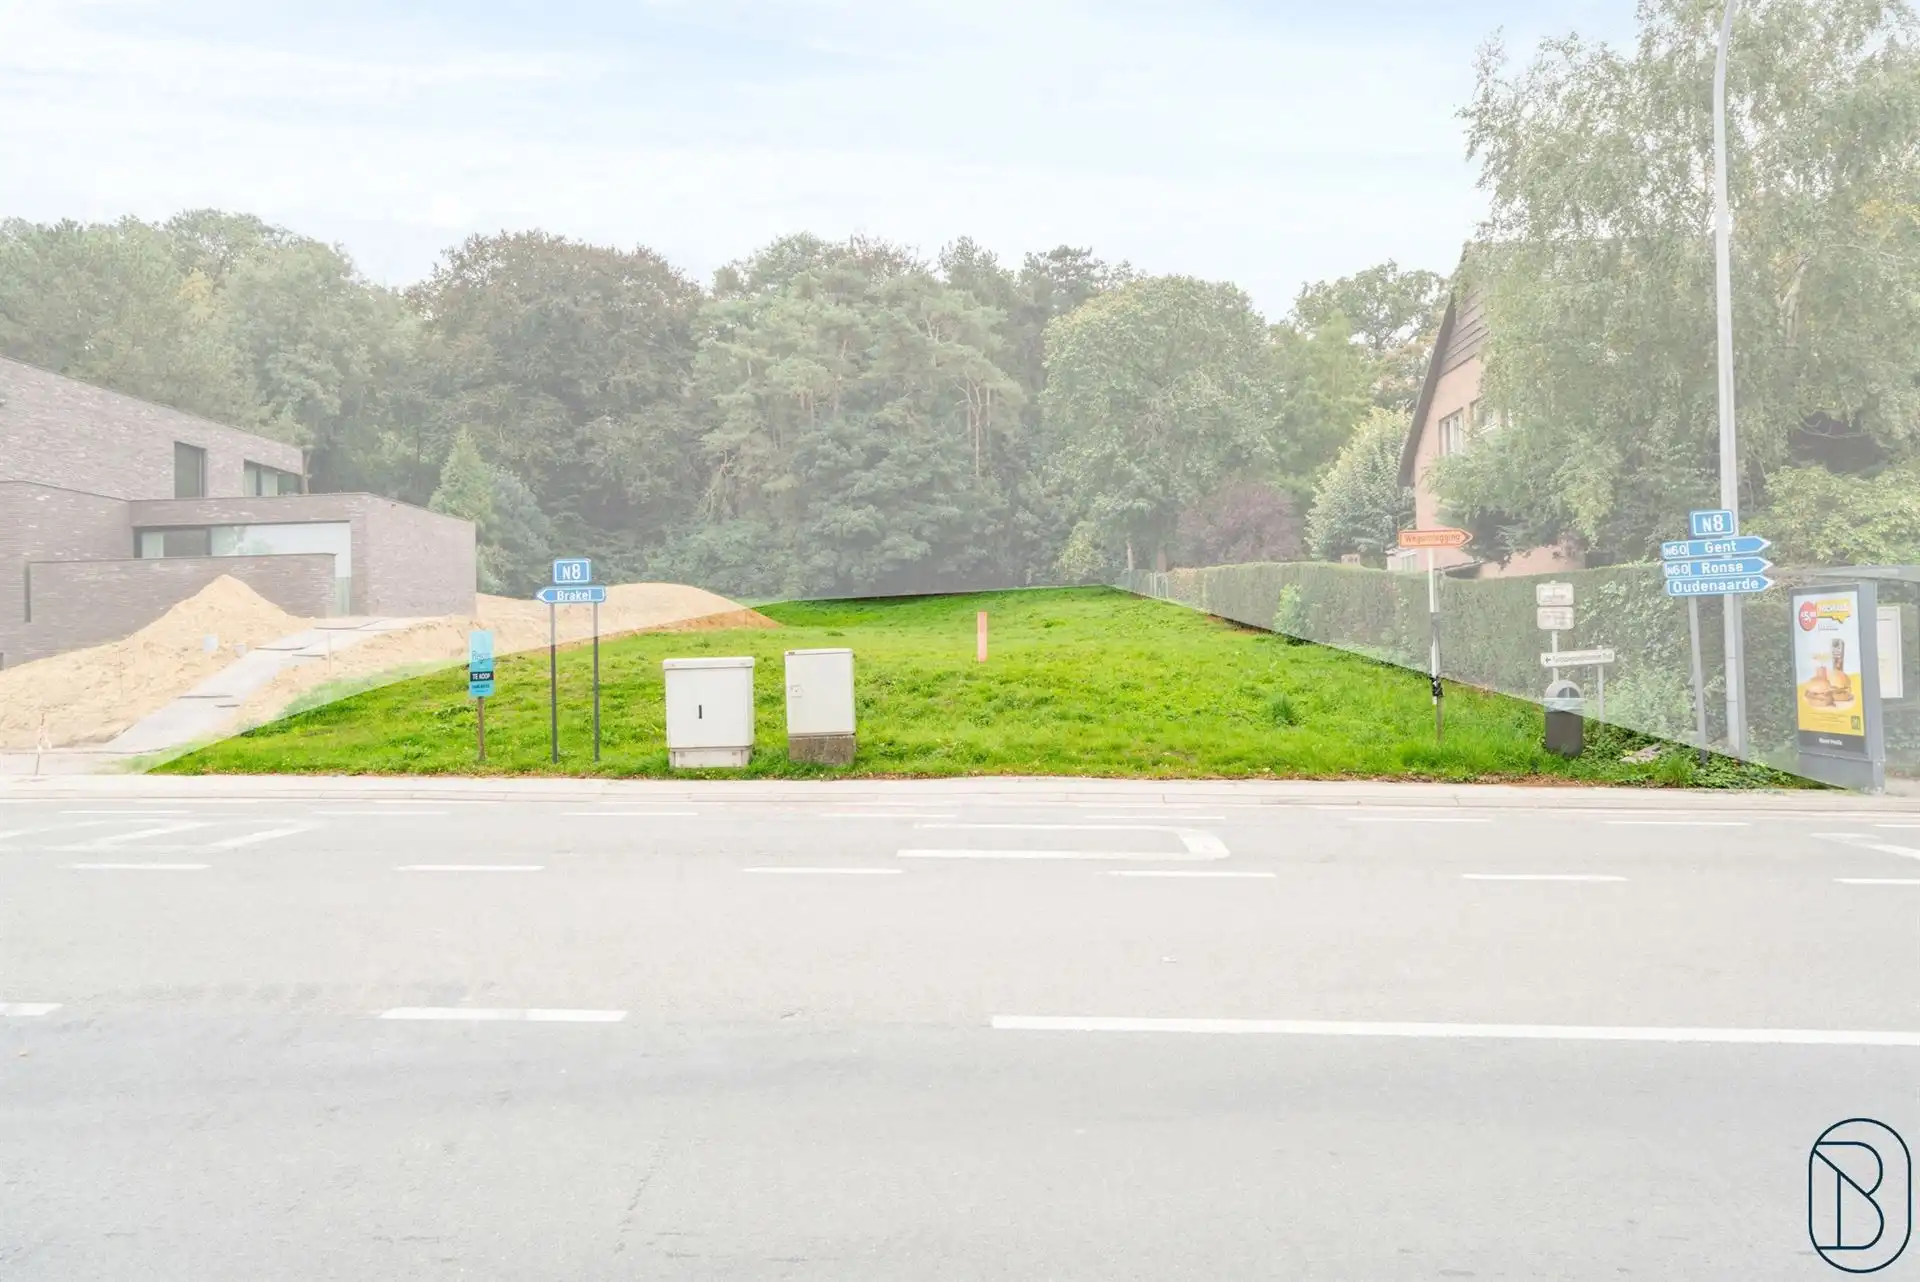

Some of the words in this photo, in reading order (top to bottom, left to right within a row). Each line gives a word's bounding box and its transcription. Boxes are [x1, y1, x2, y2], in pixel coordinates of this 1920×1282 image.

[1701, 514, 1724, 532] N8
[1404, 533, 1461, 544] Weggging
[1664, 544, 1688, 557] N60
[1704, 540, 1737, 553] Gent
[562, 563, 581, 580] N8
[1666, 564, 1689, 576] N60
[1701, 561, 1744, 574] Ronse
[1672, 577, 1760, 593] Oudenaarde
[556, 589, 592, 601] Brakel
